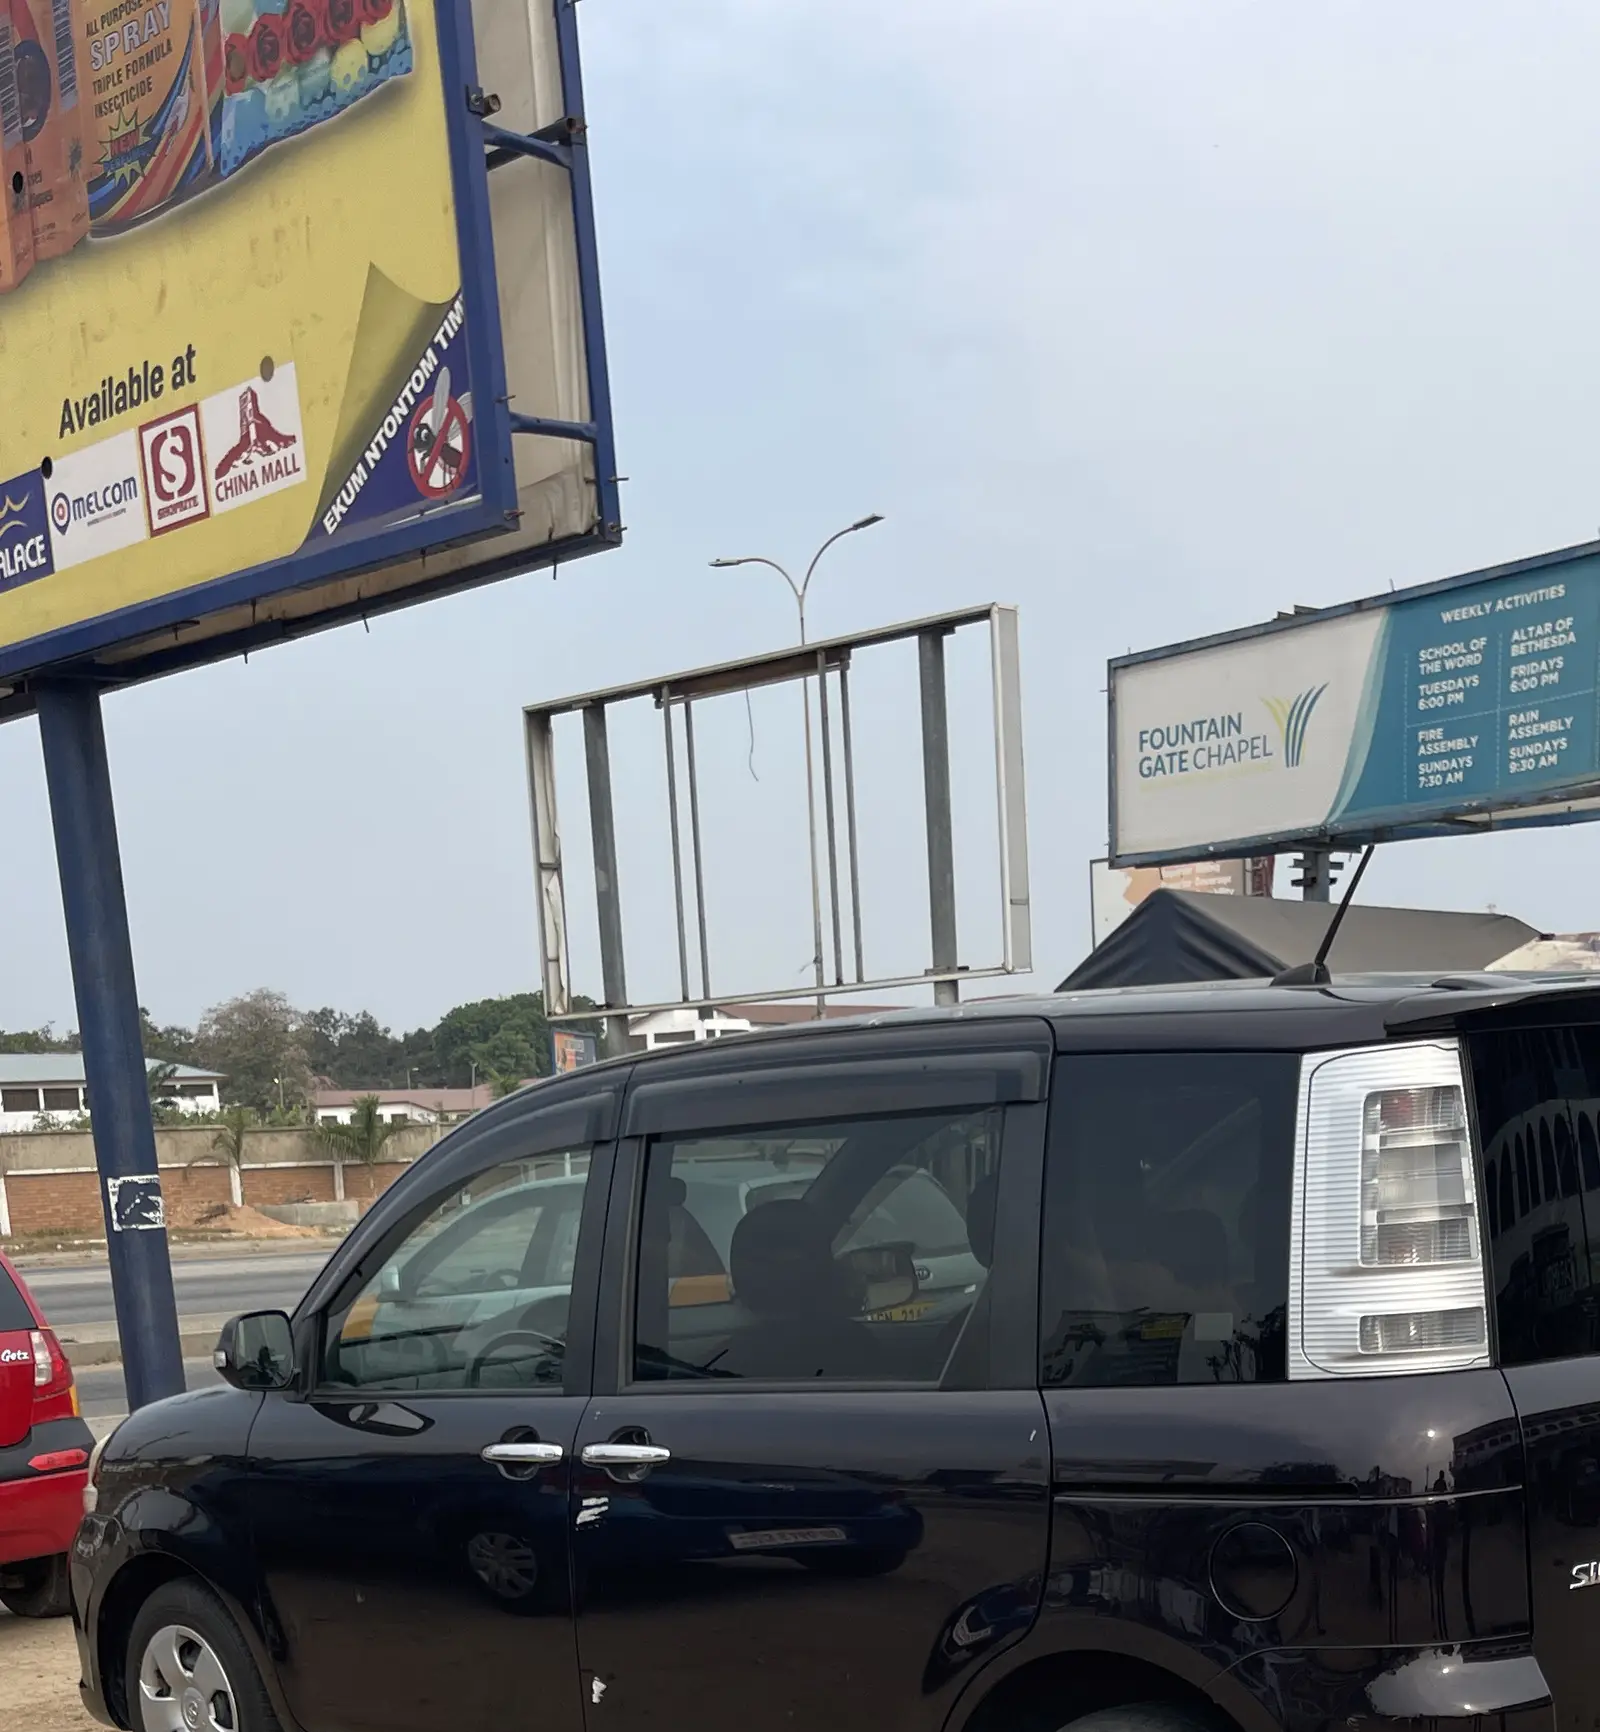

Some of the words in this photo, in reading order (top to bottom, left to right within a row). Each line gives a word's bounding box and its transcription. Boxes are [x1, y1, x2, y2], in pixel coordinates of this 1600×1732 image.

[86, 19, 100, 38] ALL
[100, 0, 143, 31] PURPOSE
[89, 0, 172, 72] SPRAY
[92, 68, 123, 95] TRIPLE
[124, 39, 173, 80] FORMULA
[94, 76, 153, 119] INSECTICIDE
[58, 360, 164, 439] Available
[171, 343, 196, 391] at
[322, 465, 368, 536] EKUM
[363, 347, 440, 470] NTONTOM
[433, 293, 464, 351] TIM
[215, 470, 260, 502] CHINA
[262, 453, 301, 486] MALL
[1440, 601, 1492, 624] WEEKLY
[1495, 584, 1566, 613] ACTIVITIES
[1511, 622, 1553, 643] ALTAR
[1554, 617, 1574, 631] OF
[1418, 642, 1468, 662] SCHOOL
[1469, 637, 1487, 651] OF
[1510, 632, 1577, 657] BETHESDA
[1418, 661, 1441, 676] THE
[1444, 653, 1483, 671] WORD
[1510, 656, 1564, 679] FRIDAYS
[1418, 675, 1480, 697] TUESDAYS
[1509, 679, 1538, 693] 6:00
[1540, 672, 1559, 687] PM
[1417, 696, 1445, 711] 6:00
[1447, 691, 1464, 706] PM
[1508, 710, 1539, 727] RAIN
[1508, 716, 1574, 740] ASSEMBLY
[1138, 712, 1242, 753] FOUNTAIN
[1417, 728, 1444, 742] FIRE
[1138, 750, 1189, 779] GATE
[1193, 735, 1273, 770] CHAPEL
[1417, 735, 1479, 757] ASSEMBLY
[1508, 737, 1568, 760] SUNDAYS
[1418, 755, 1473, 775] SUNDAYS
[1509, 759, 1535, 774] 9:30
[1538, 754, 1558, 769] AM
[1418, 775, 1443, 788] 7:30
[1445, 771, 1464, 785] AM
[1, 1349, 30, 1362] Getz
[1569, 1561, 1600, 1590] SI
